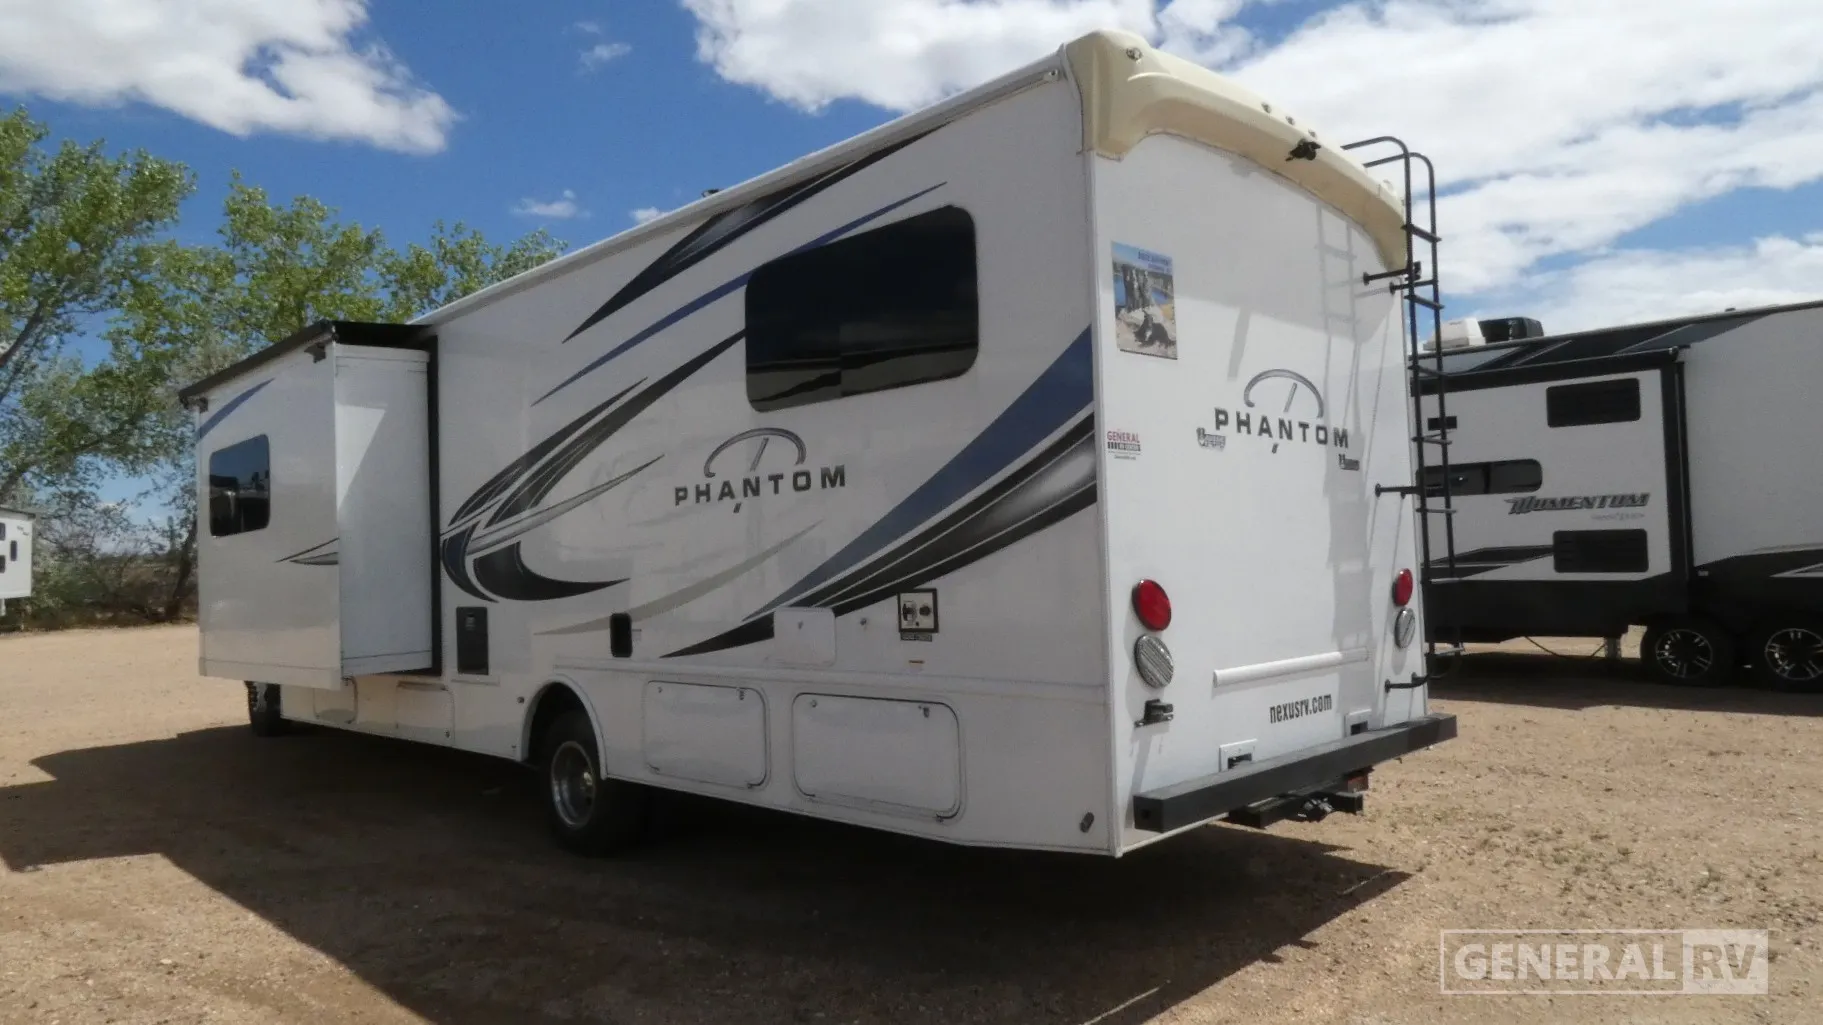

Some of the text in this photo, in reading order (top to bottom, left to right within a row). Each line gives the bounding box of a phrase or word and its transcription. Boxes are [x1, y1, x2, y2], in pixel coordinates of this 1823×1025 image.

[1107, 431, 1140, 443] GENERAL
[1214, 407, 1349, 449] PHANTOM
[674, 464, 846, 506] PHANTOM
[1504, 492, 1650, 515] MOMENTUM
[1269, 693, 1332, 724] nexusrv.com
